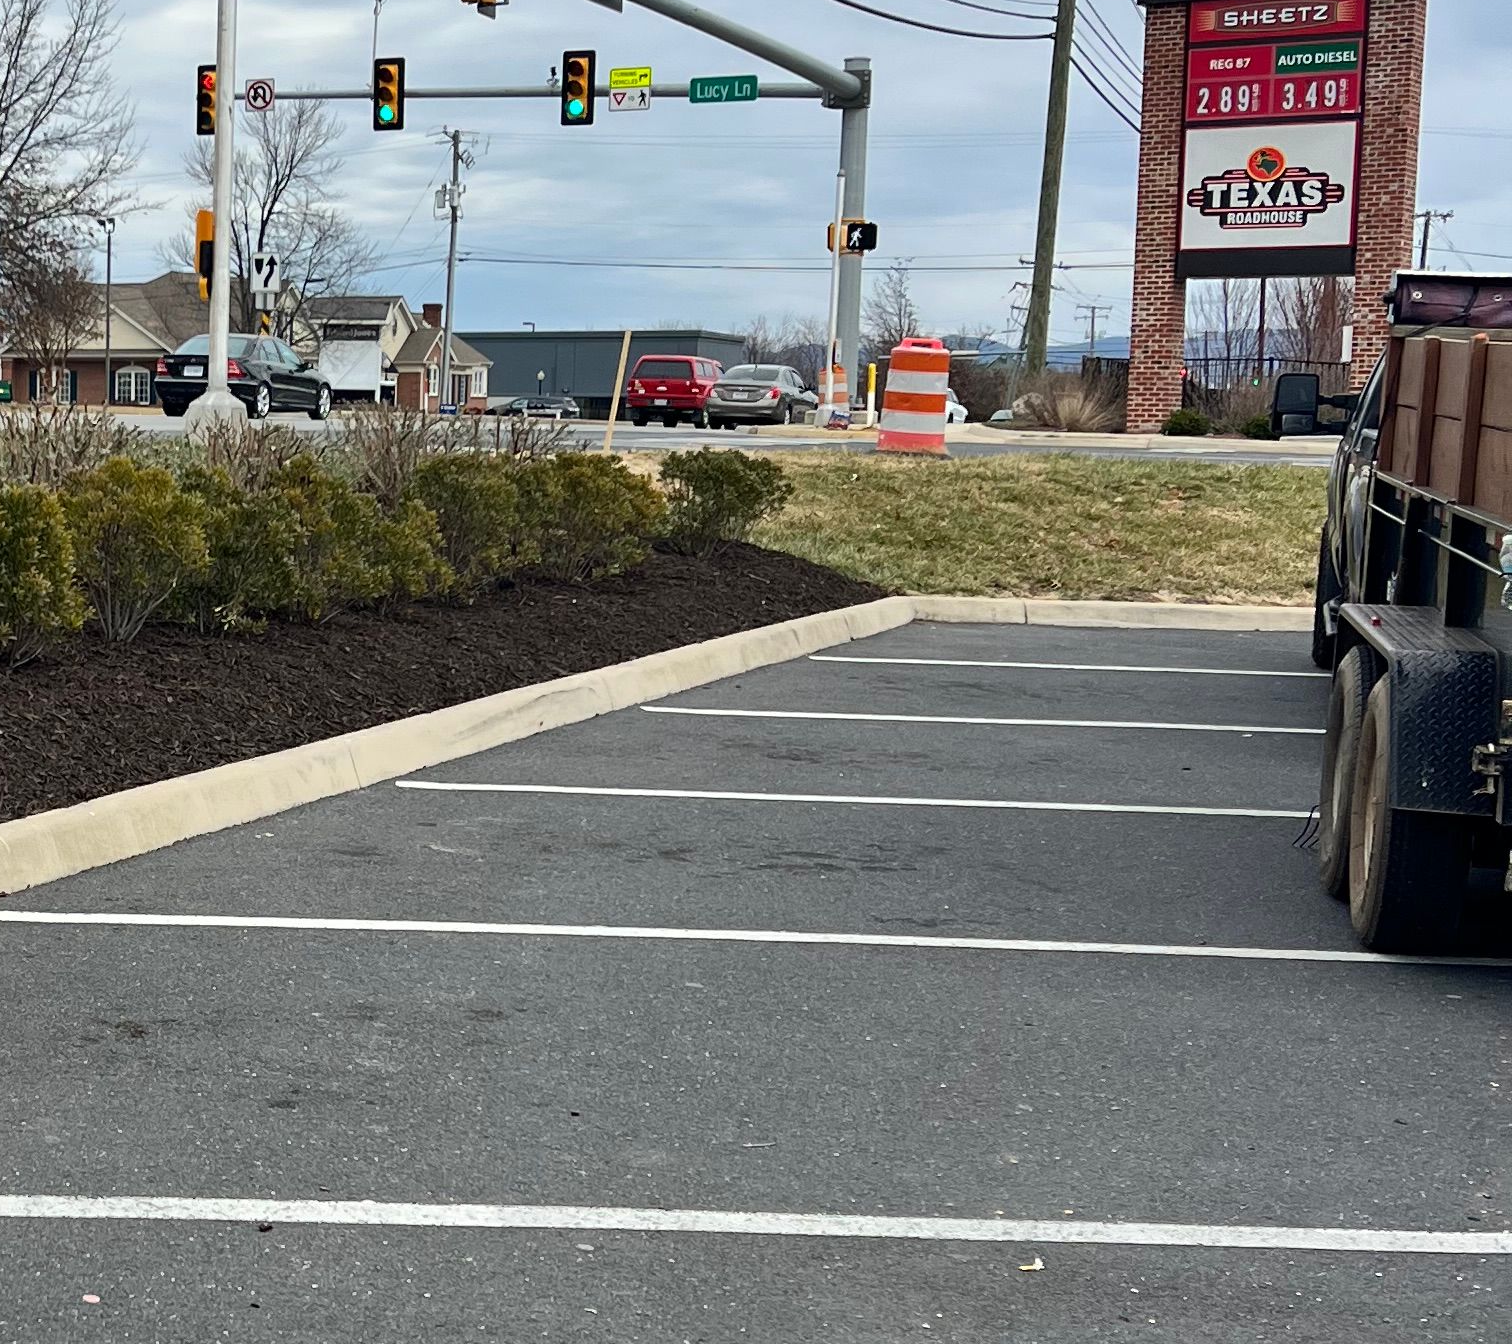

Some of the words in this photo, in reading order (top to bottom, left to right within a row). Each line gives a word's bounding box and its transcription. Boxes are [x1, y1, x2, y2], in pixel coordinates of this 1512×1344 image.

[1223, 5, 1329, 27] SHEETZ
[1209, 58, 1234, 70] REG
[1235, 57, 1251, 69] 87
[1277, 53, 1313, 66] AUTO
[1314, 50, 1358, 64] DIESEL
[696, 82, 729, 102] Lucy
[734, 80, 751, 97] Ln
[1205, 179, 1323, 208] TEXAS
[1226, 210, 1304, 225] ROADHOUSE
